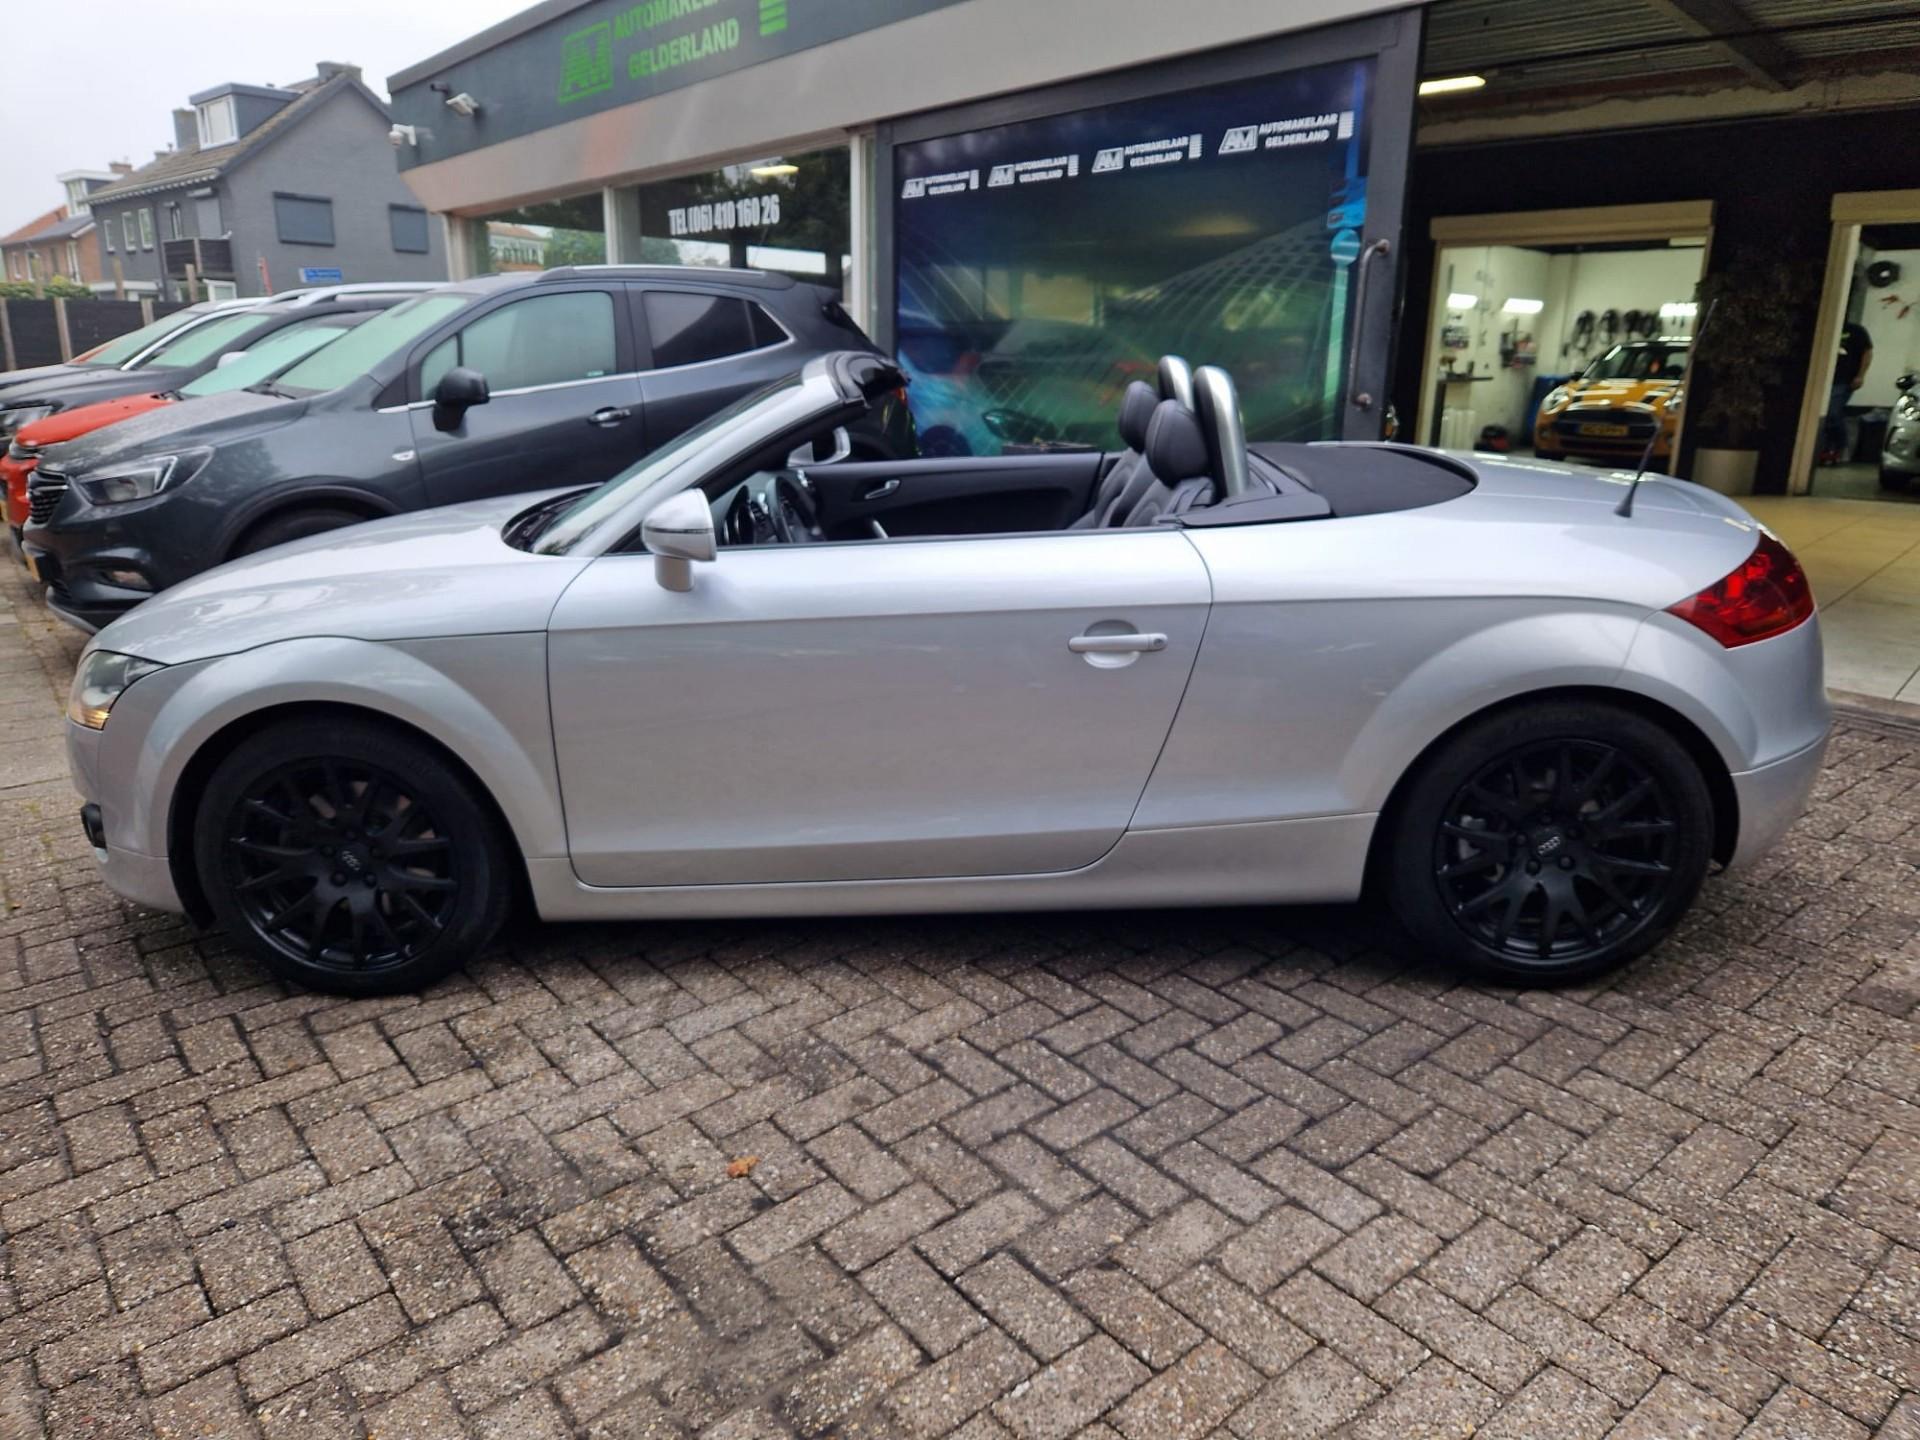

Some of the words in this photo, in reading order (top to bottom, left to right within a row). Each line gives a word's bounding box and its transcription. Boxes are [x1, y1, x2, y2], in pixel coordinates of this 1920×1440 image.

[628, 18, 740, 80] GELDERLAND
[1259, 113, 1338, 134] AUTOMAKELAAR
[1125, 136, 1189, 156] AUTOMAKELAAR
[1222, 127, 1257, 152] AM
[1265, 129, 1330, 149] GELDERLAND
[1094, 148, 1123, 172] AM
[1130, 151, 1182, 168] GELDERLAND
[668, 207, 688, 236] TEL
[687, 203, 713, 233] (06)
[714, 200, 736, 230] 410
[736, 197, 760, 227] 160
[761, 194, 780, 224] 26
